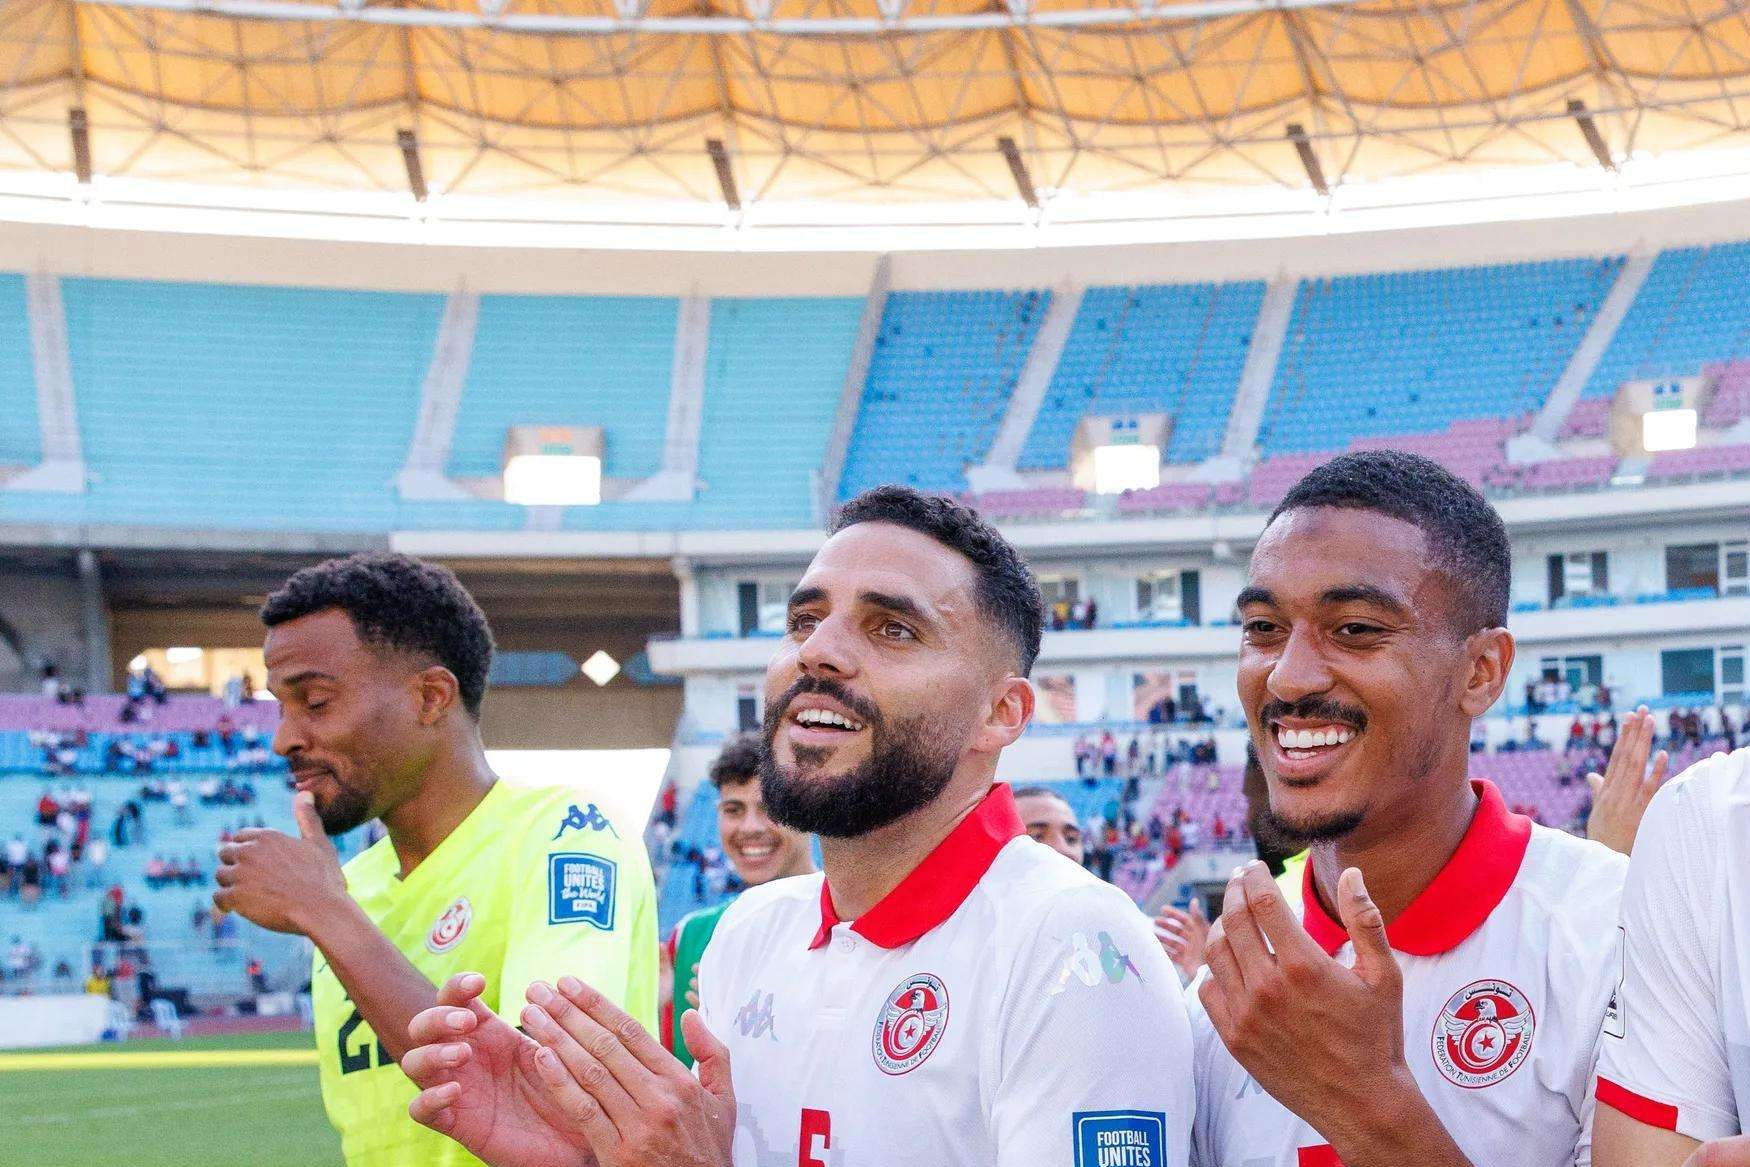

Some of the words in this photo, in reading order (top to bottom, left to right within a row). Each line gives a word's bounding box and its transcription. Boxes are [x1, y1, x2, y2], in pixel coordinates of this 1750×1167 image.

[339, 993, 396, 1076] 2
[1097, 1130, 1150, 1146] FOOTBALL
[1098, 1146, 1151, 1167] UNITES
